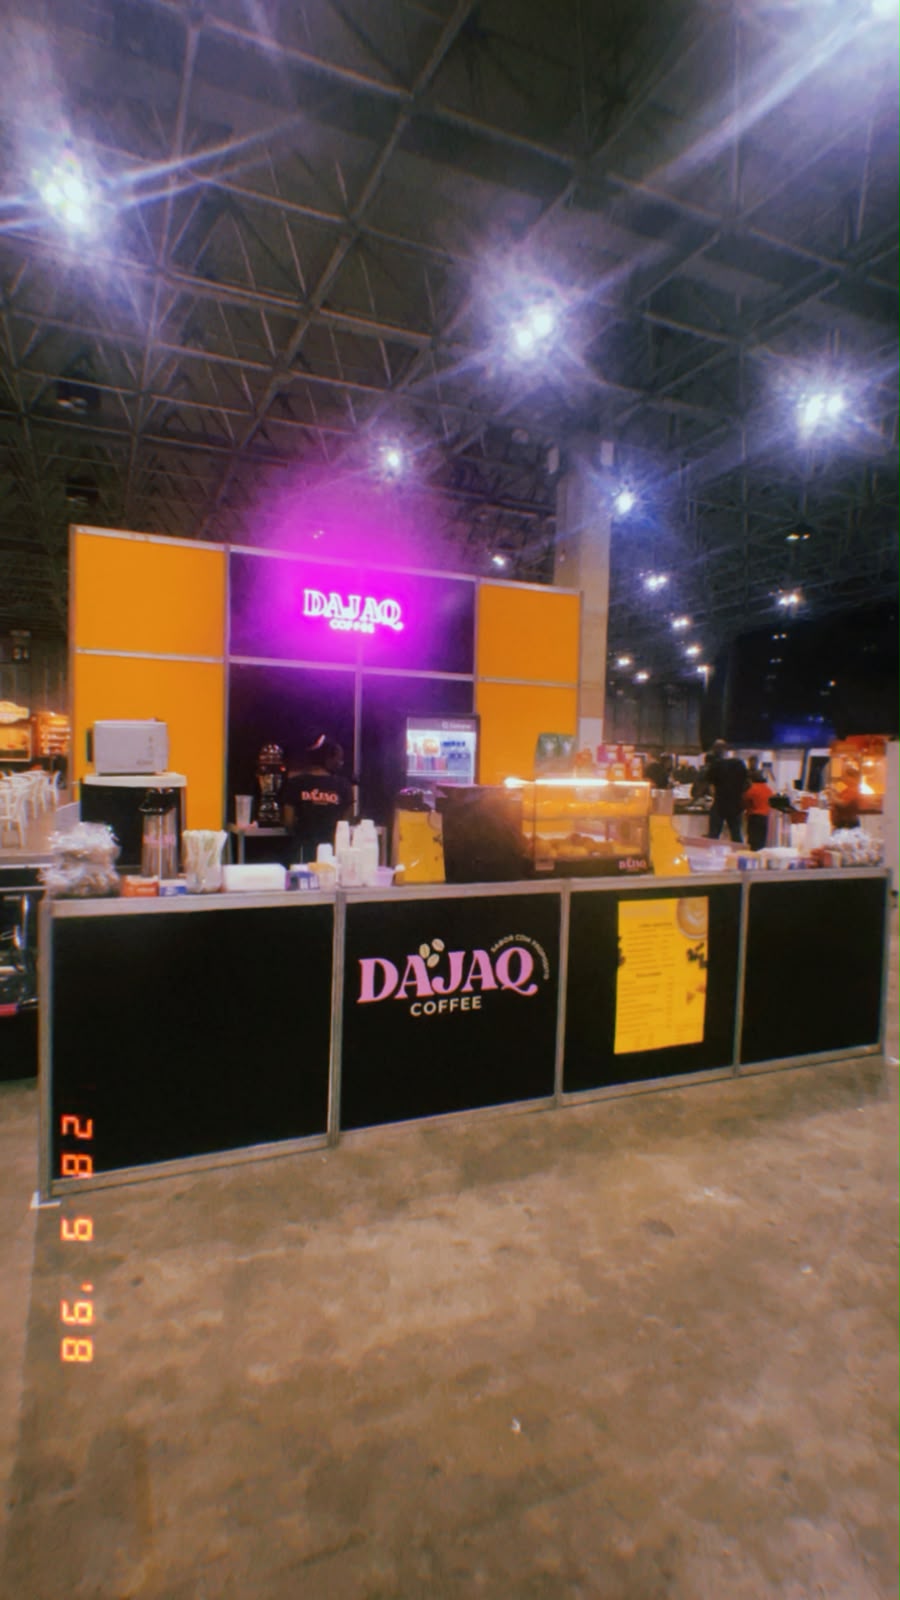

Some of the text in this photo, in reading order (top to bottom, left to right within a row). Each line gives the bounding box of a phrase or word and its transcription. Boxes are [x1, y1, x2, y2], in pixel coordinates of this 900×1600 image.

[304, 589, 403, 631] DAJAQ
[356, 947, 539, 1004] DAJAQ
[410, 996, 482, 1017] COFFEE
